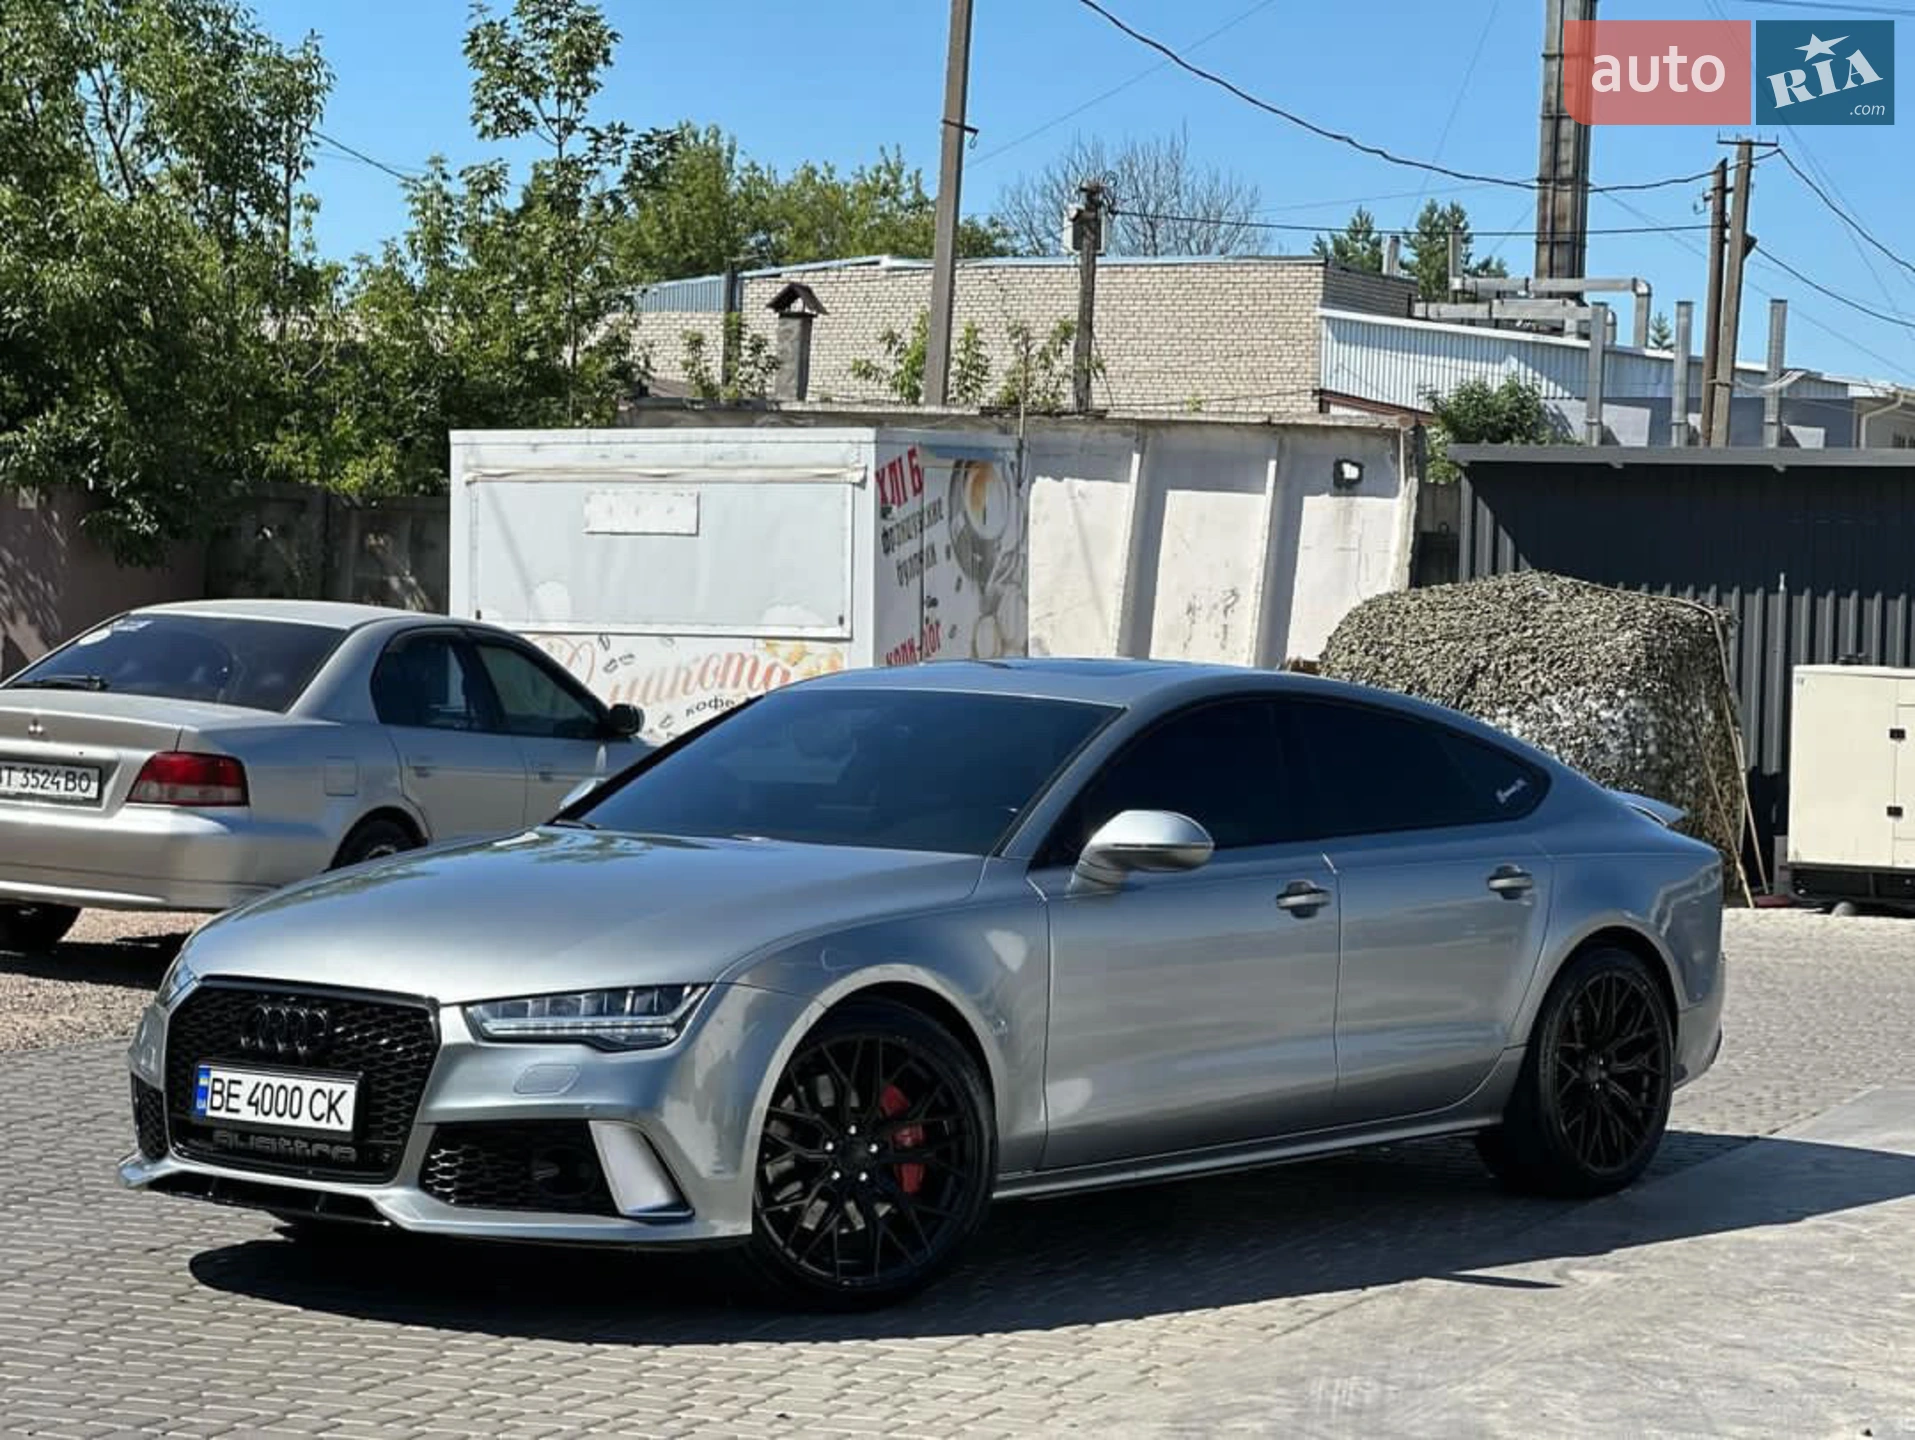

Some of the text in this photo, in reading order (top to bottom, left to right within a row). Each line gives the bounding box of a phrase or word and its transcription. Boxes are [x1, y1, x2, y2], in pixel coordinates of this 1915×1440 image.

[20, 767, 60, 791] 3524
[209, 1077, 348, 1126] BE 4000 CK
